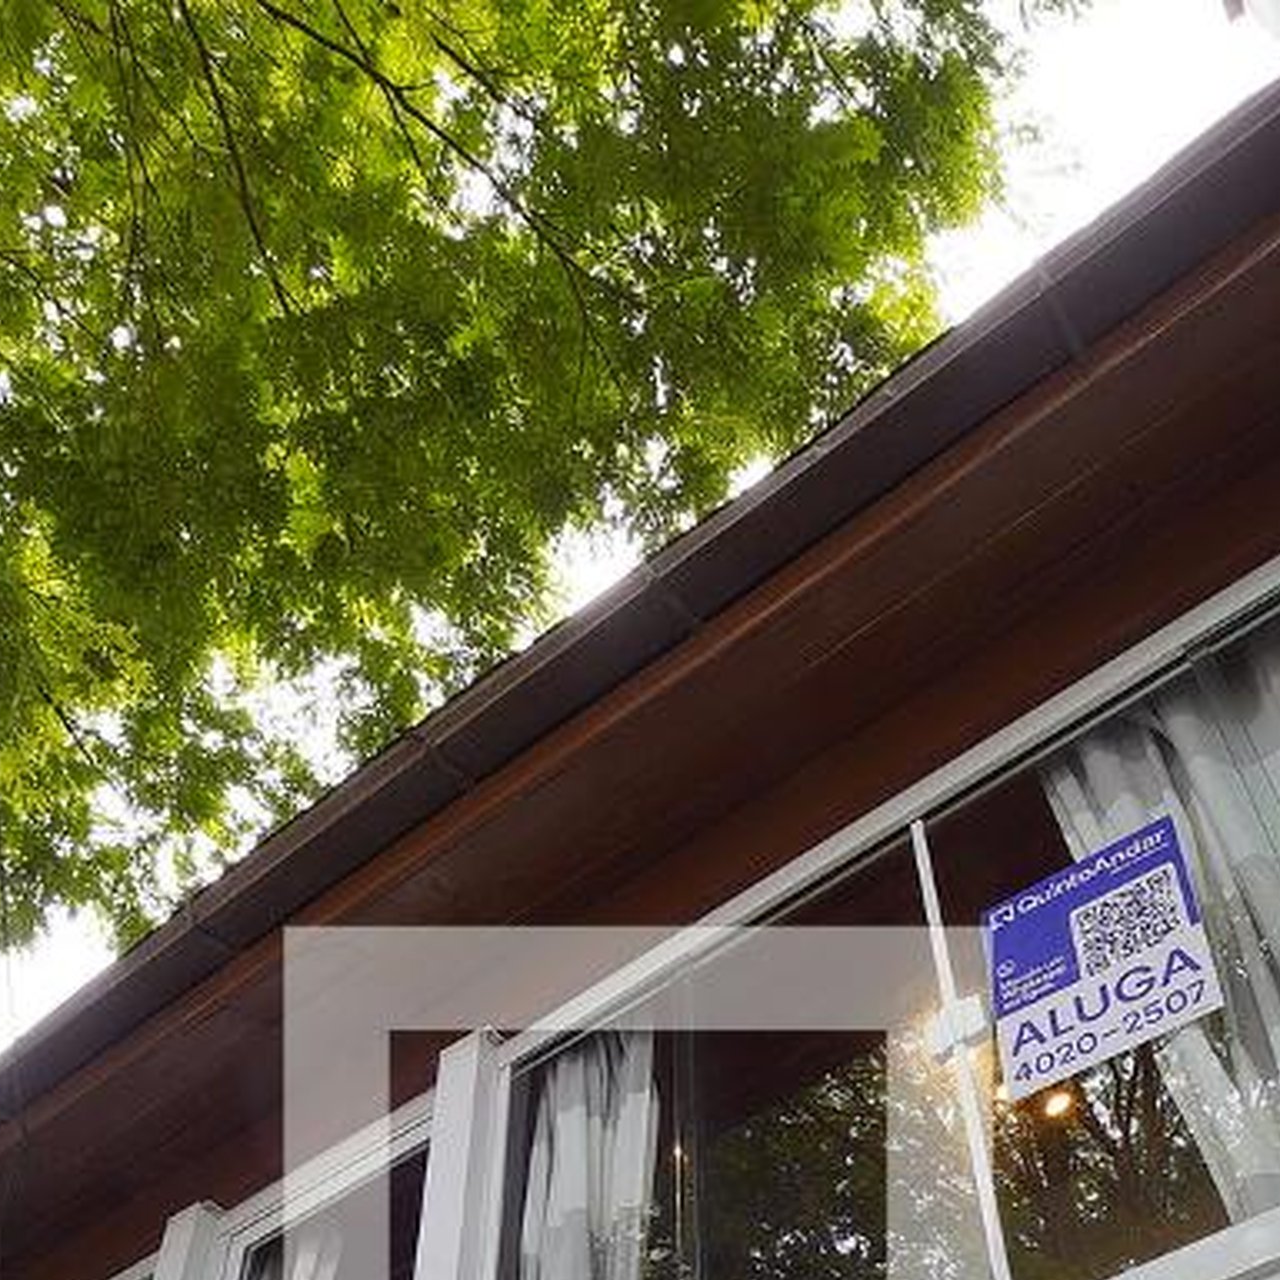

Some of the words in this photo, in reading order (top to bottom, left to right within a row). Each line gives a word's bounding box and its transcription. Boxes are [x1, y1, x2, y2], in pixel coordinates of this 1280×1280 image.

[1017, 829, 1166, 914] QuintoAndar
[1012, 947, 1202, 1057] ALUGA
[1014, 979, 1206, 1082] 4020-2507
